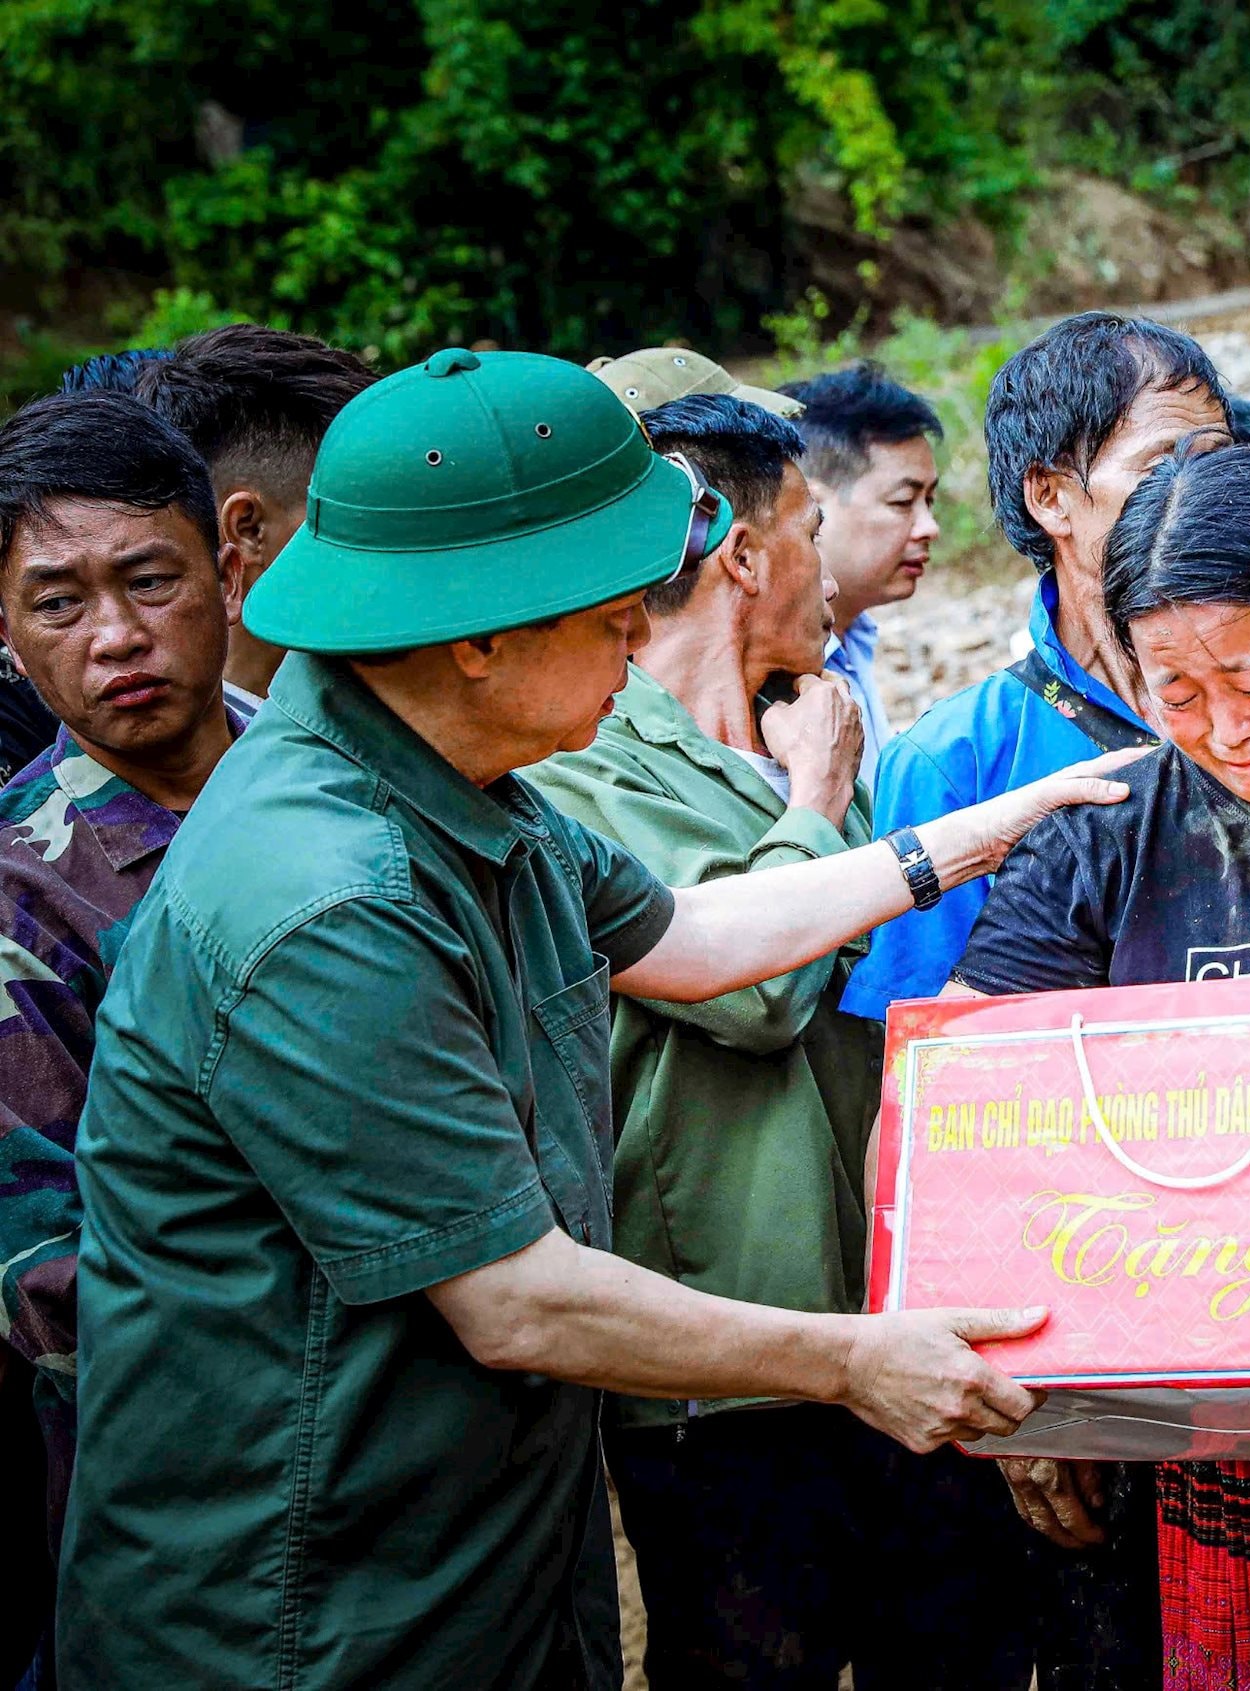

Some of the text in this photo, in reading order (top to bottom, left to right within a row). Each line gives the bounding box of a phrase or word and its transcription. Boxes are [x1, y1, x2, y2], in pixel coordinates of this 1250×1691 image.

[928, 1103, 977, 1152] BAN
[982, 1081, 1023, 1149] CHỈ
[1166, 1071, 1209, 1140] THỦ
